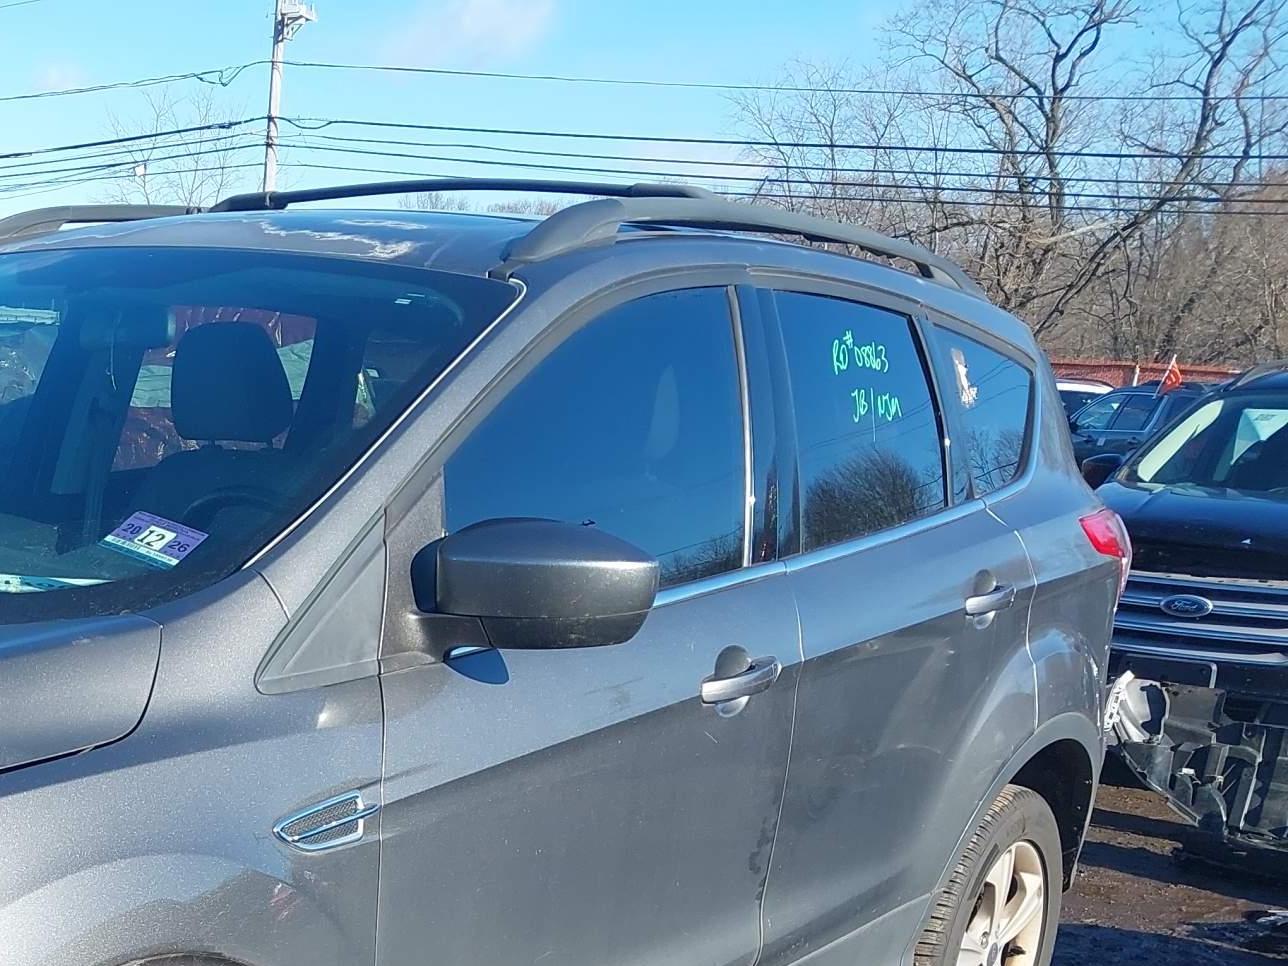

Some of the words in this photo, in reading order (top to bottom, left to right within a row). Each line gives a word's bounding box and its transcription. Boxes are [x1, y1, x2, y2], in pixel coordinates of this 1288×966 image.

[121, 522, 143, 535] 20
[136, 529, 166, 547] 12
[167, 540, 191, 554] 26
